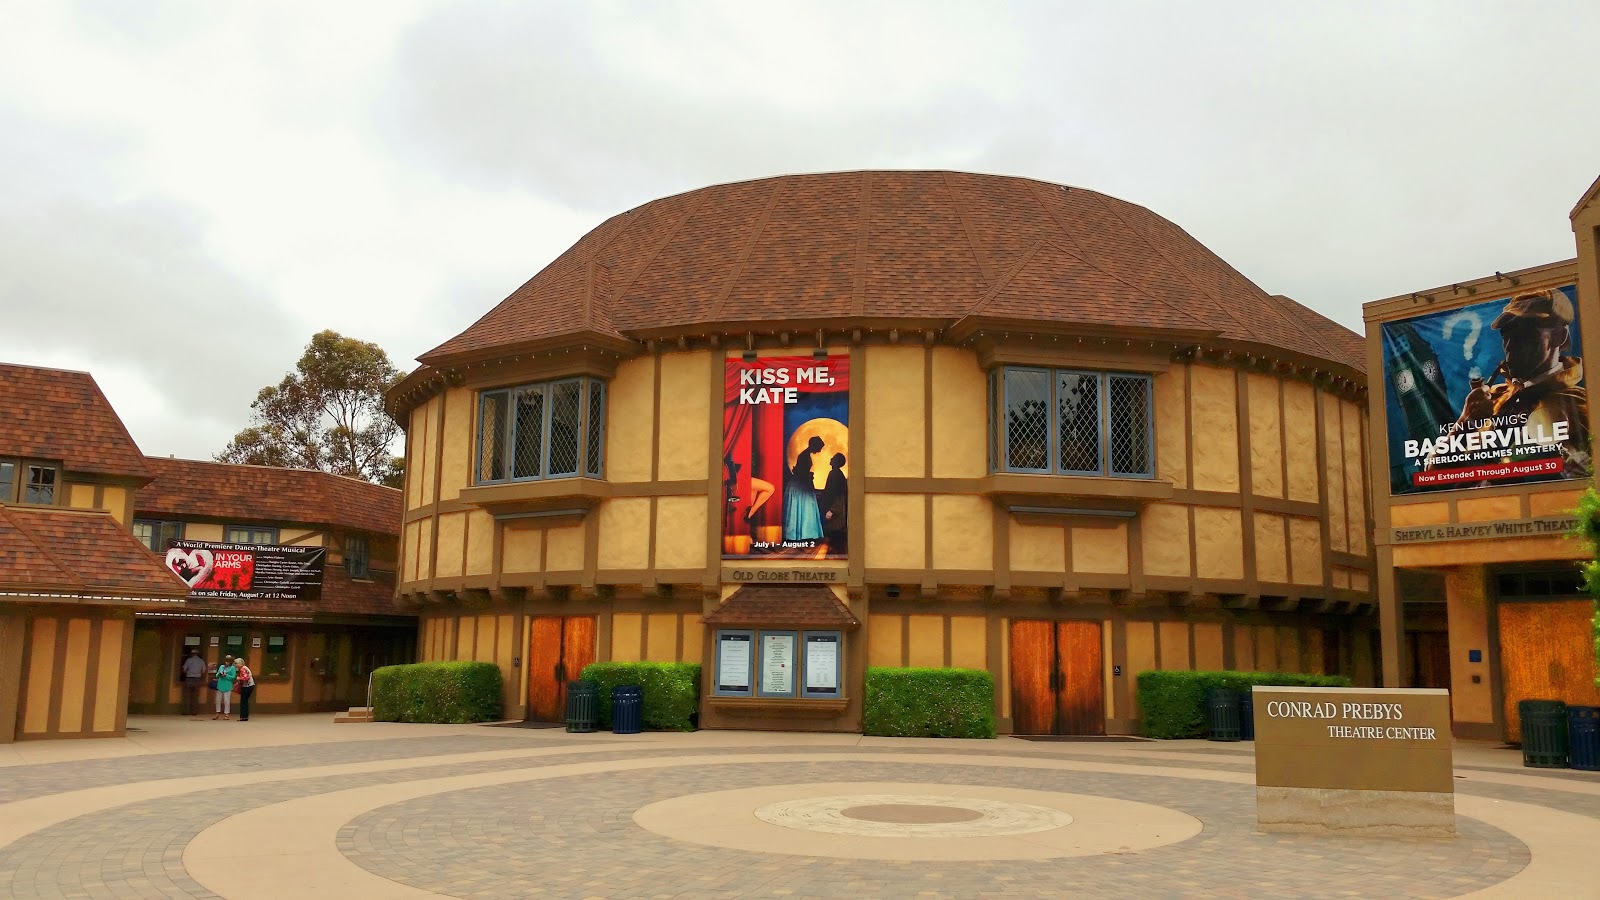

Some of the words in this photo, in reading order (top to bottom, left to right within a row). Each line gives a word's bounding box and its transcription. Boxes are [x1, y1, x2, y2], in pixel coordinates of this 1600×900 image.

[740, 368, 790, 385] KISS
[796, 366, 835, 386] ME,
[740, 387, 798, 405] KATE
[1439, 421, 1464, 433] KEN
[1467, 413, 1528, 430] LUDWIG'S
[1404, 420, 1569, 458] BASKERVILLE
[1414, 458, 1421, 466] A
[1423, 453, 1471, 466] SHERLOCK
[1473, 449, 1513, 461] HOLMES
[1515, 443, 1563, 456] MYSTERY
[1437, 471, 1475, 481] Extended
[1476, 467, 1511, 477] Through
[1512, 464, 1543, 474] August
[1545, 462, 1557, 470] 30
[1395, 528, 1435, 541] SHERYL
[1436, 529, 1445, 538] &
[1446, 525, 1493, 538] HARVEY
[1493, 522, 1533, 535] WHITE
[234, 544, 280, 552] Dance-Theatre
[753, 541, 770, 549] July
[782, 541, 809, 549] August
[214, 560, 242, 569] ARMS
[215, 553, 226, 561] IN
[227, 553, 253, 562] YOUR
[733, 570, 754, 581] OLD
[757, 570, 790, 581] GLOBE
[792, 570, 837, 581] THEATRE
[219, 590, 238, 598] Friday,
[1267, 701, 1337, 719] CONRAD
[1342, 703, 1403, 720] PREBYS
[1327, 725, 1384, 739] THEATRE
[1385, 727, 1437, 740] CENTER
